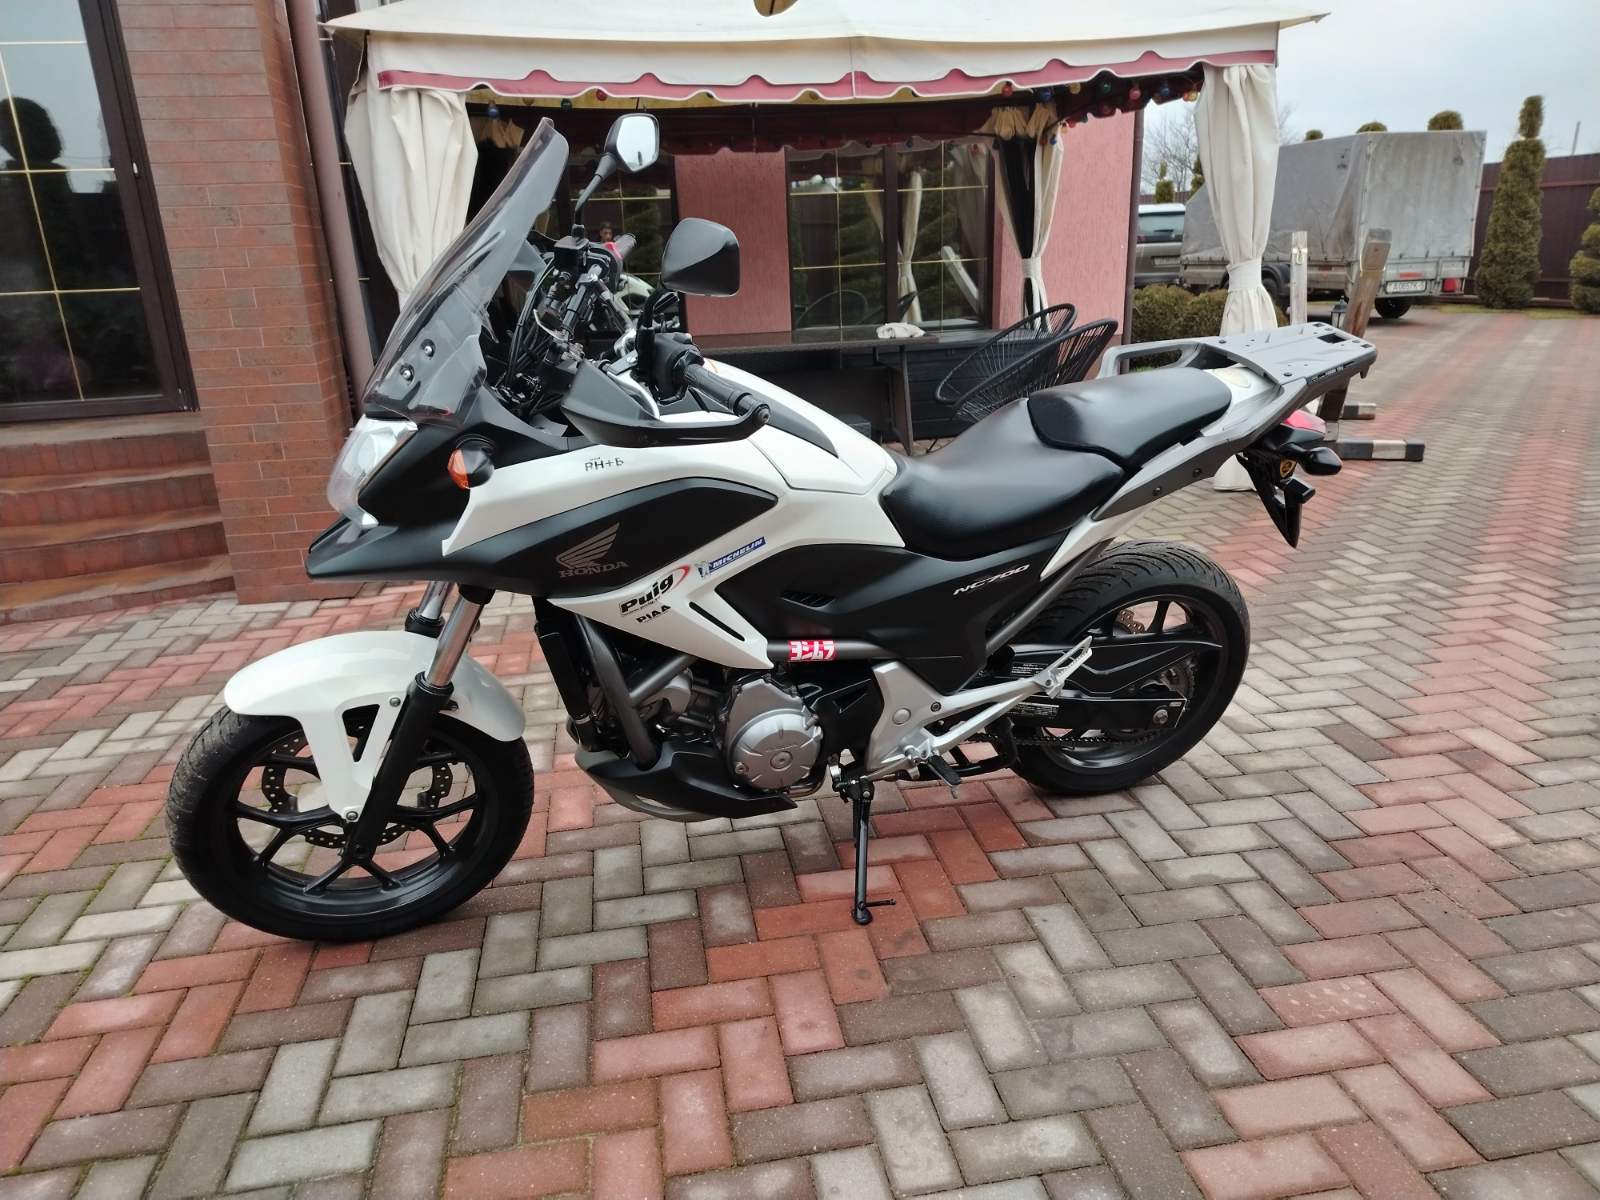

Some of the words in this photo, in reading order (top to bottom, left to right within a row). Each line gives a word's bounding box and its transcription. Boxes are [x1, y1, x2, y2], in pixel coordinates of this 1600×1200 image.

[712, 539, 763, 568] MICHELIN
[559, 561, 629, 578] HONDA
[953, 564, 1030, 595] NC700
[620, 574, 674, 613] Puig
[636, 604, 671, 623] PIAA
[790, 640, 834, 661] ヨシムラ
